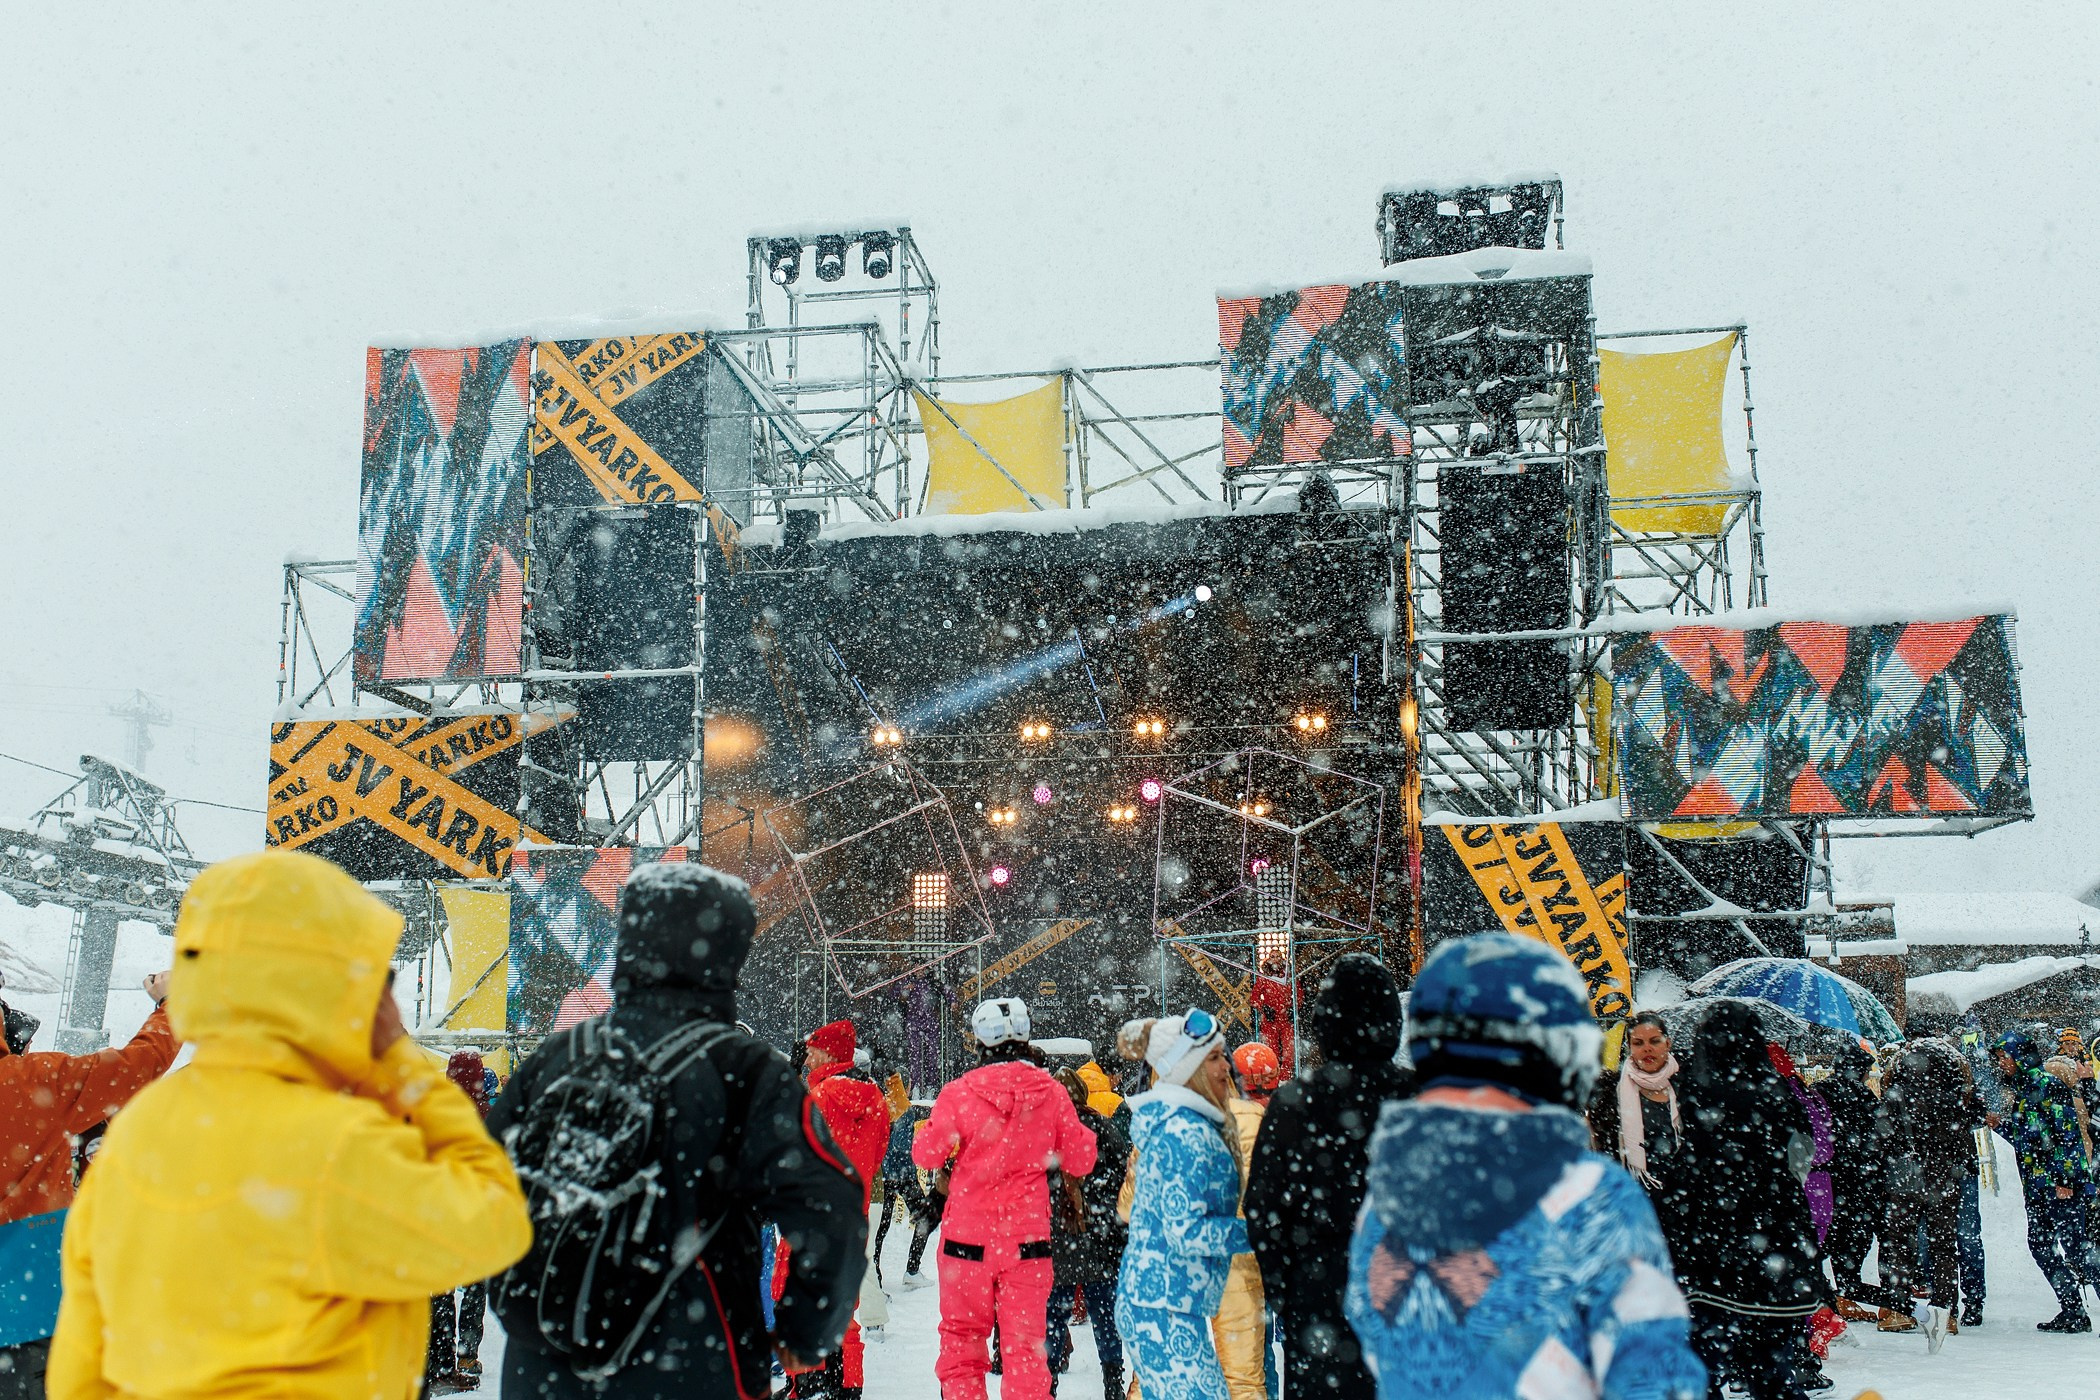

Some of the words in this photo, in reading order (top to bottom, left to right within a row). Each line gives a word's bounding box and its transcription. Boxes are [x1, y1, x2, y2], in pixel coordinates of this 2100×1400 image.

[578, 339, 624, 385] RKO
[609, 364, 637, 396] JV
[327, 742, 394, 799] JV
[389, 775, 511, 878] YARK
